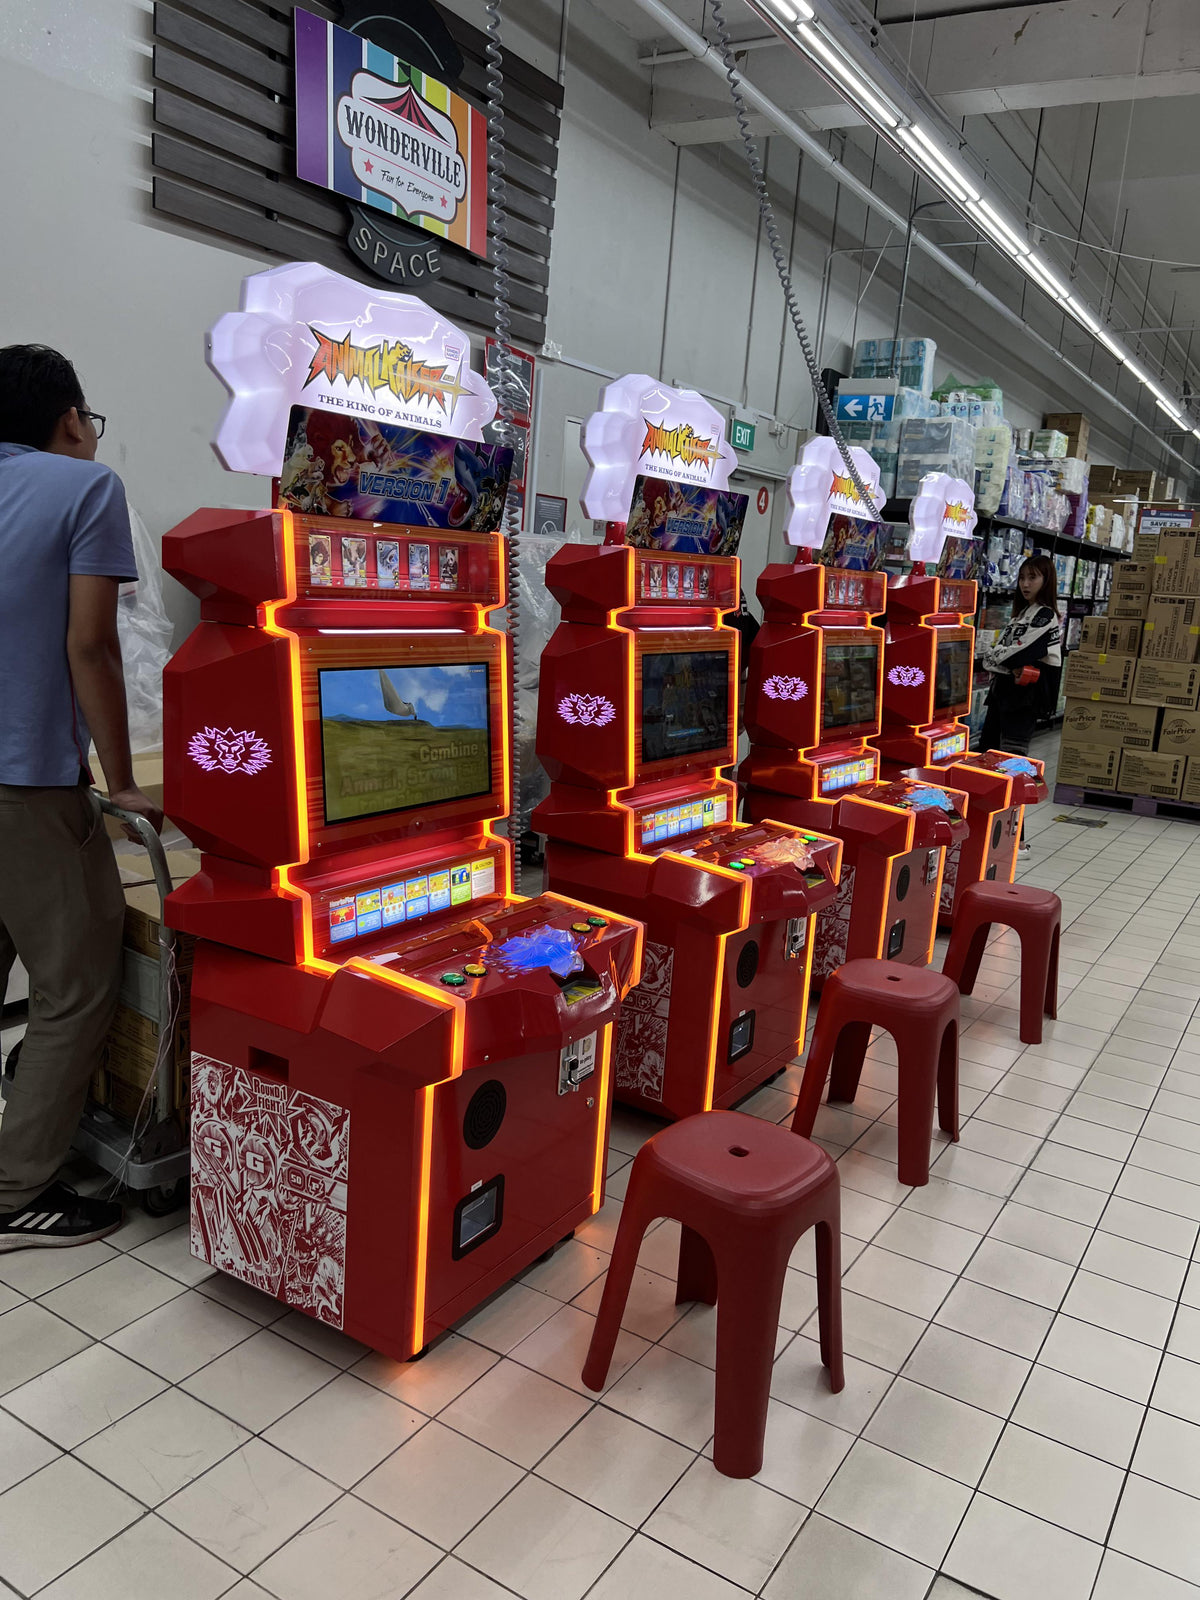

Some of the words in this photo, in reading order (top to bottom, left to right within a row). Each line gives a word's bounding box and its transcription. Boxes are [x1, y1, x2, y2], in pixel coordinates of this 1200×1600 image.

[344, 104, 461, 188] WONDERVILLE
[380, 169, 395, 184] Fun
[395, 176, 405, 188] for
[406, 181, 435, 201] Everyone
[355, 227, 441, 278] SPACE
[318, 393, 344, 407] THE
[346, 399, 376, 414] KING
[378, 407, 393, 417] OF
[394, 411, 442, 428] ANIMALS
[735, 426, 751, 446] EXIT
[645, 463, 658, 472] THE
[658, 467, 673, 476] KING
[682, 472, 707, 484] ANIMALS
[360, 471, 437, 502] VERSION
[437, 477, 452, 504] 1
[759, 491, 766, 510] 4
[666, 516, 706, 536] VERSION
[705, 517, 714, 538] 1
[1065, 714, 1096, 722] FairPrice
[1163, 727, 1196, 736] FairPrice
[419, 741, 479, 763] Combine
[252, 1076, 281, 1100] ROUND
[203, 1136, 222, 1159] G
[245, 1151, 265, 1174] G
